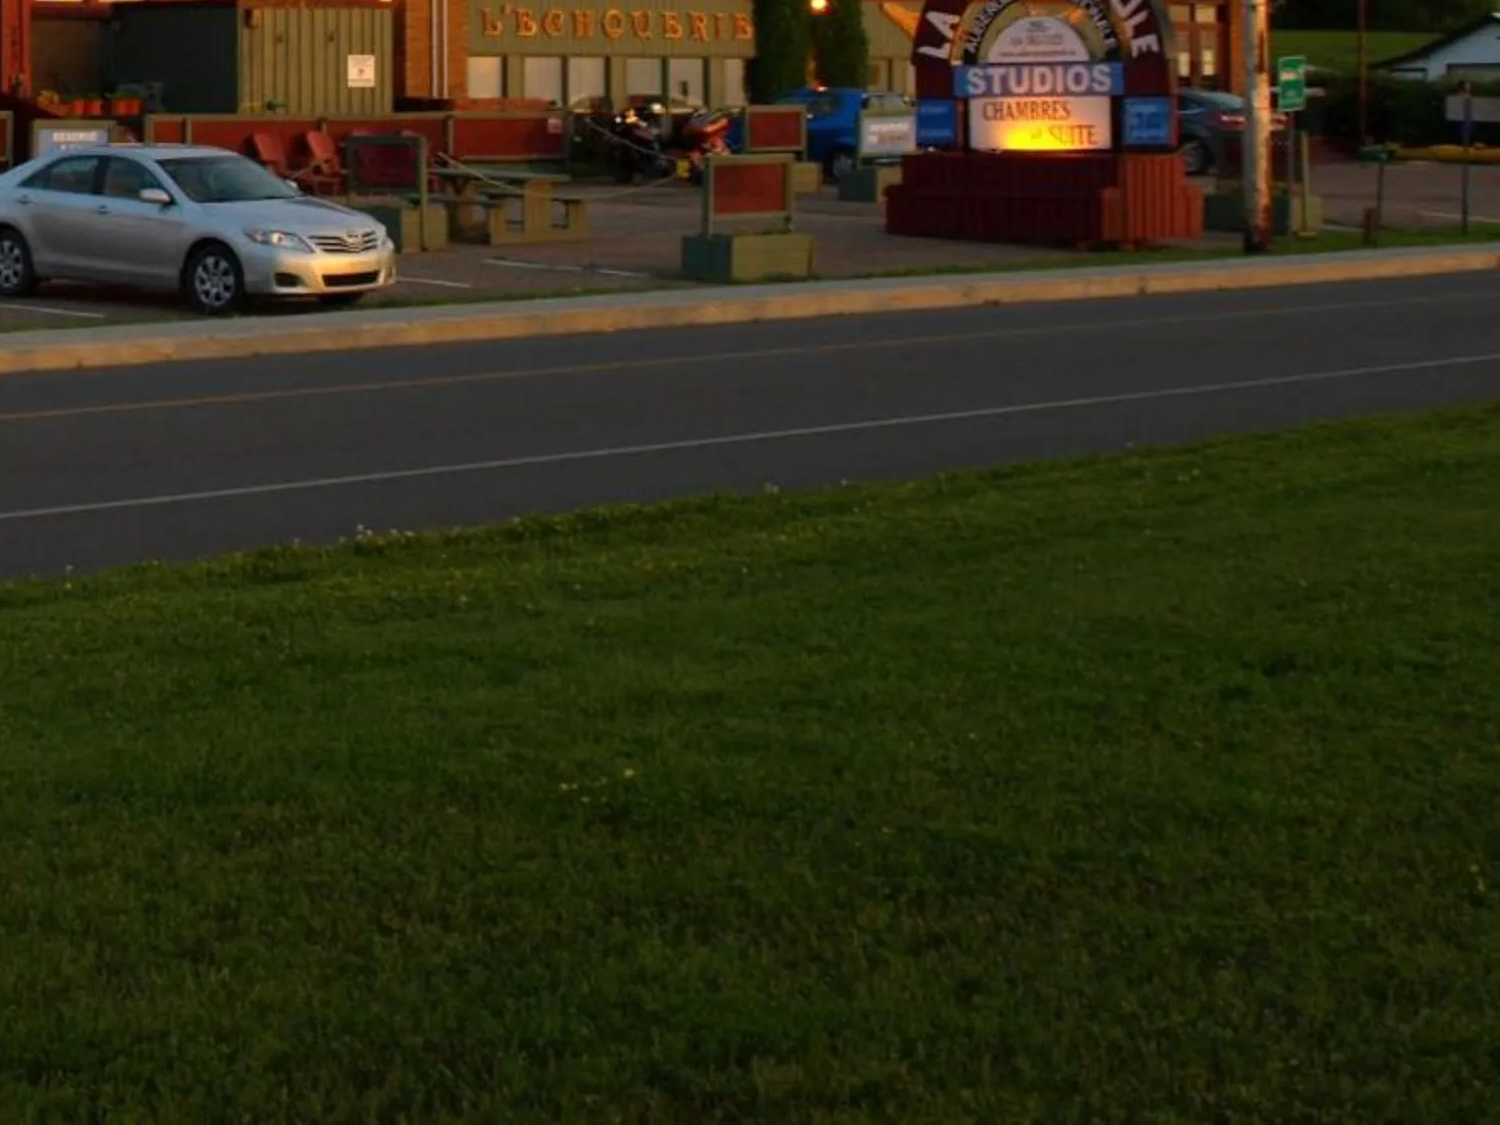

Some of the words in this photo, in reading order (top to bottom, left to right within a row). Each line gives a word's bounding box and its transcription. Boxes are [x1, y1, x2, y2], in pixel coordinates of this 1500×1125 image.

[916, 10, 960, 60] LA
[967, 64, 1111, 94] STUDIOS
[982, 101, 1071, 122] CHAMBRES
[1048, 124, 1097, 146] SUITE
